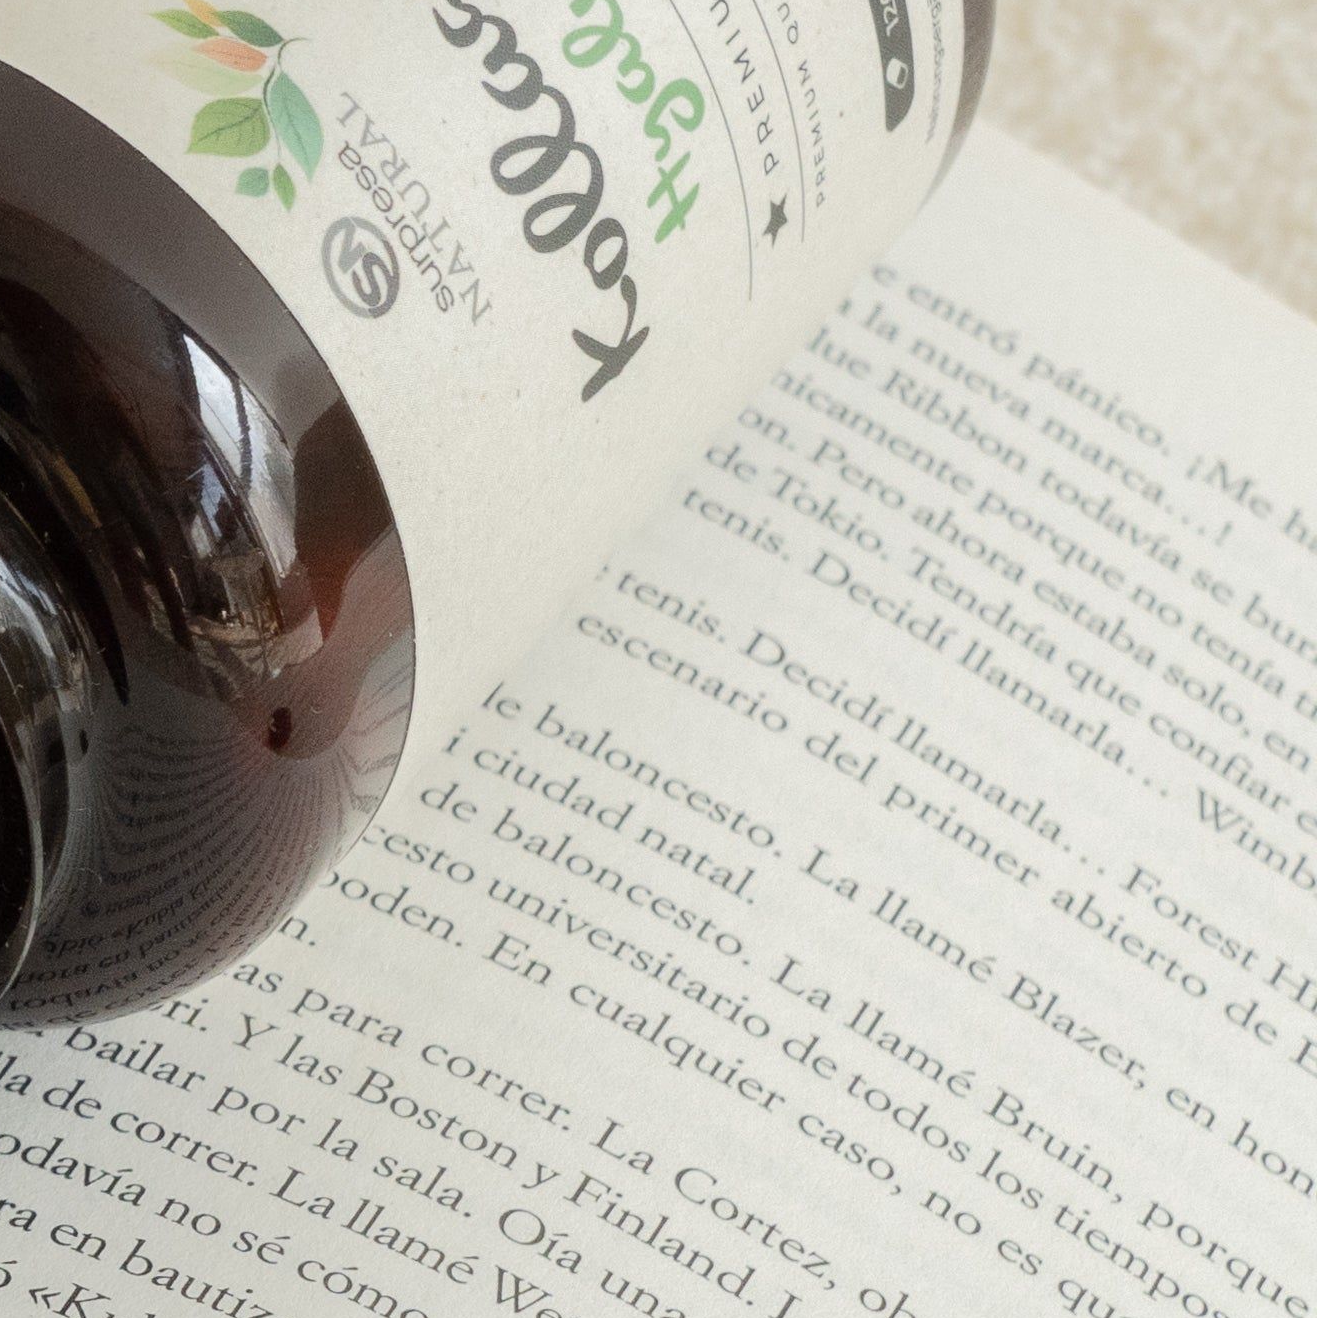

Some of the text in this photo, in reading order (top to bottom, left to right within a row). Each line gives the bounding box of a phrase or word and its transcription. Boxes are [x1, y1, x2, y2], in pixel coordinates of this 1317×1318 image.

[336, 91, 493, 326] NATURAL
[337, 140, 455, 313] surpresa
[796, 60, 827, 209] PREMIUM
[880, 368, 1183, 573] Ribbon todavía
[909, 337, 1032, 422] nueva
[1022, 352, 1274, 519] pánico. ¡Me
[681, 487, 958, 653] tenis. Decidí
[471, 748, 757, 906] ciudad natal.
[575, 614, 1209, 999] escenario del primer abierto
[742, 628, 1257, 971] Decidí Forest
[533, 702, 1217, 1132] baloncesto. La llamé Blazer, en
[289, 987, 405, 1049] para
[419, 1043, 572, 1133] correr.
[592, 1116, 656, 1177] La
[673, 1166, 837, 1292] Cortez,
